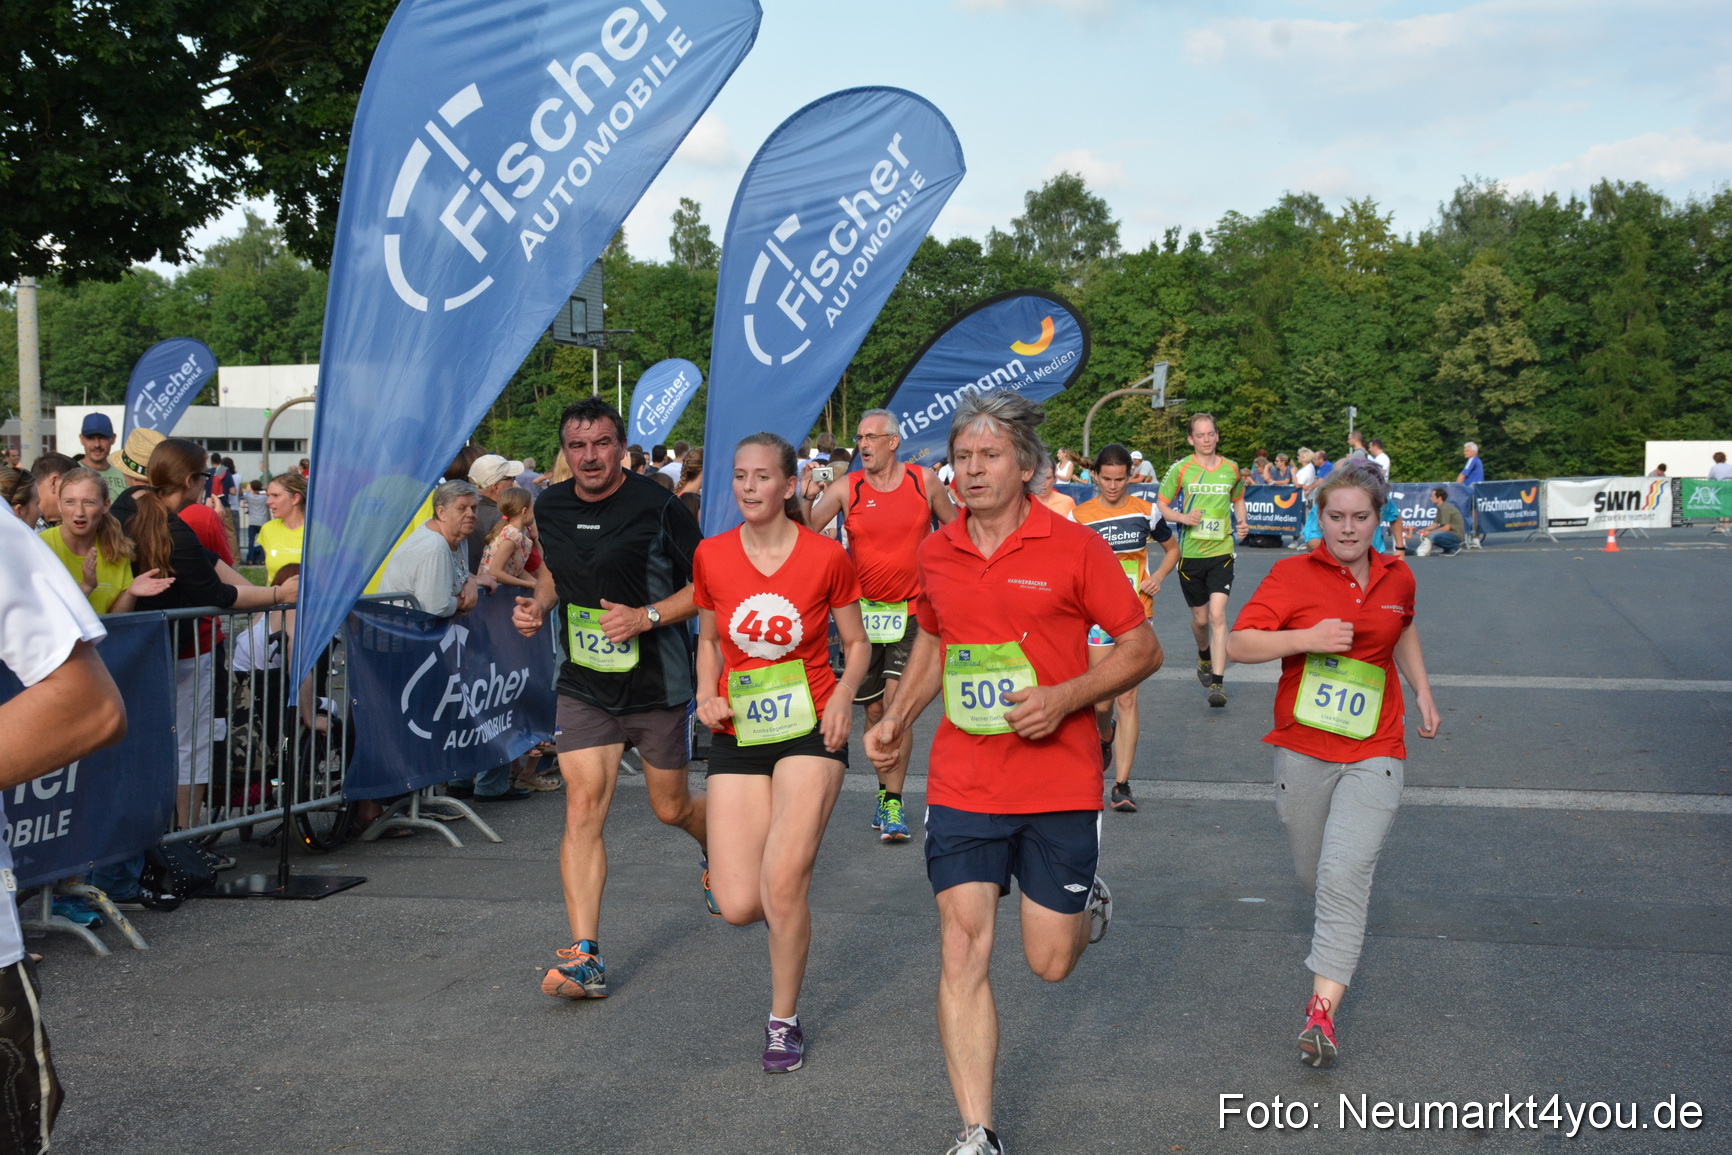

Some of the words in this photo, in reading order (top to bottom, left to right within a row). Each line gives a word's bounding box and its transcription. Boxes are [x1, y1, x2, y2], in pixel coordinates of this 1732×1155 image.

[439, 0, 668, 263] Fischer
[519, 26, 693, 262] AUTOMOBILE
[776, 132, 910, 331] Fischer
[825, 169, 926, 328] AUTOMOBILE
[145, 353, 197, 421] Fischer
[1011, 374, 1034, 391] und
[1033, 350, 1075, 380] Medien
[162, 366, 203, 420] AUTOMOBILE
[646, 370, 686, 426] Fischer
[660, 381, 691, 425] AUTOMOBILE
[1188, 483, 1232, 495] BOCK
[1477, 497, 1523, 512] Frischmann
[1594, 490, 1641, 513] swn
[1688, 485, 1722, 505] AOK
[1102, 530, 1140, 541] Fischer
[1247, 513, 1262, 521] Druck
[1262, 514, 1274, 522] und
[1274, 515, 1297, 523] Medien
[736, 609, 793, 646] 48
[862, 614, 902, 630] 1376
[746, 693, 793, 723] 497
[961, 678, 1017, 710] 508
[1314, 683, 1366, 717] 510
[442, 709, 513, 751] AUTOMOBILE
